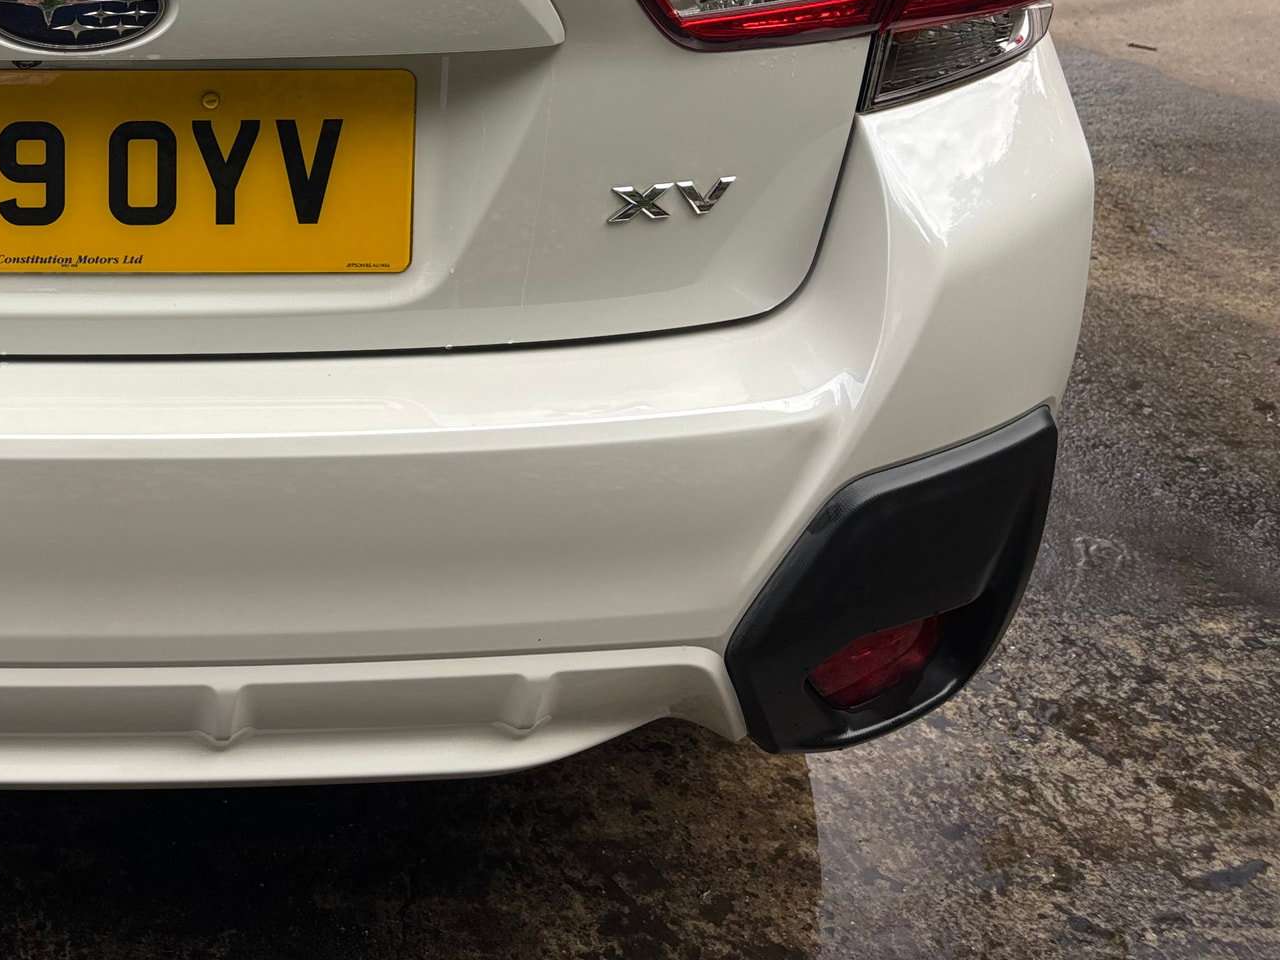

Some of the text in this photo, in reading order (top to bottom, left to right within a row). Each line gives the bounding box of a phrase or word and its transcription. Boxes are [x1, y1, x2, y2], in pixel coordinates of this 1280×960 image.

[108, 119, 344, 226] OYV
[608, 176, 736, 223] XV
[76, 254, 119, 265] Motors
[122, 254, 144, 265] Ltd
